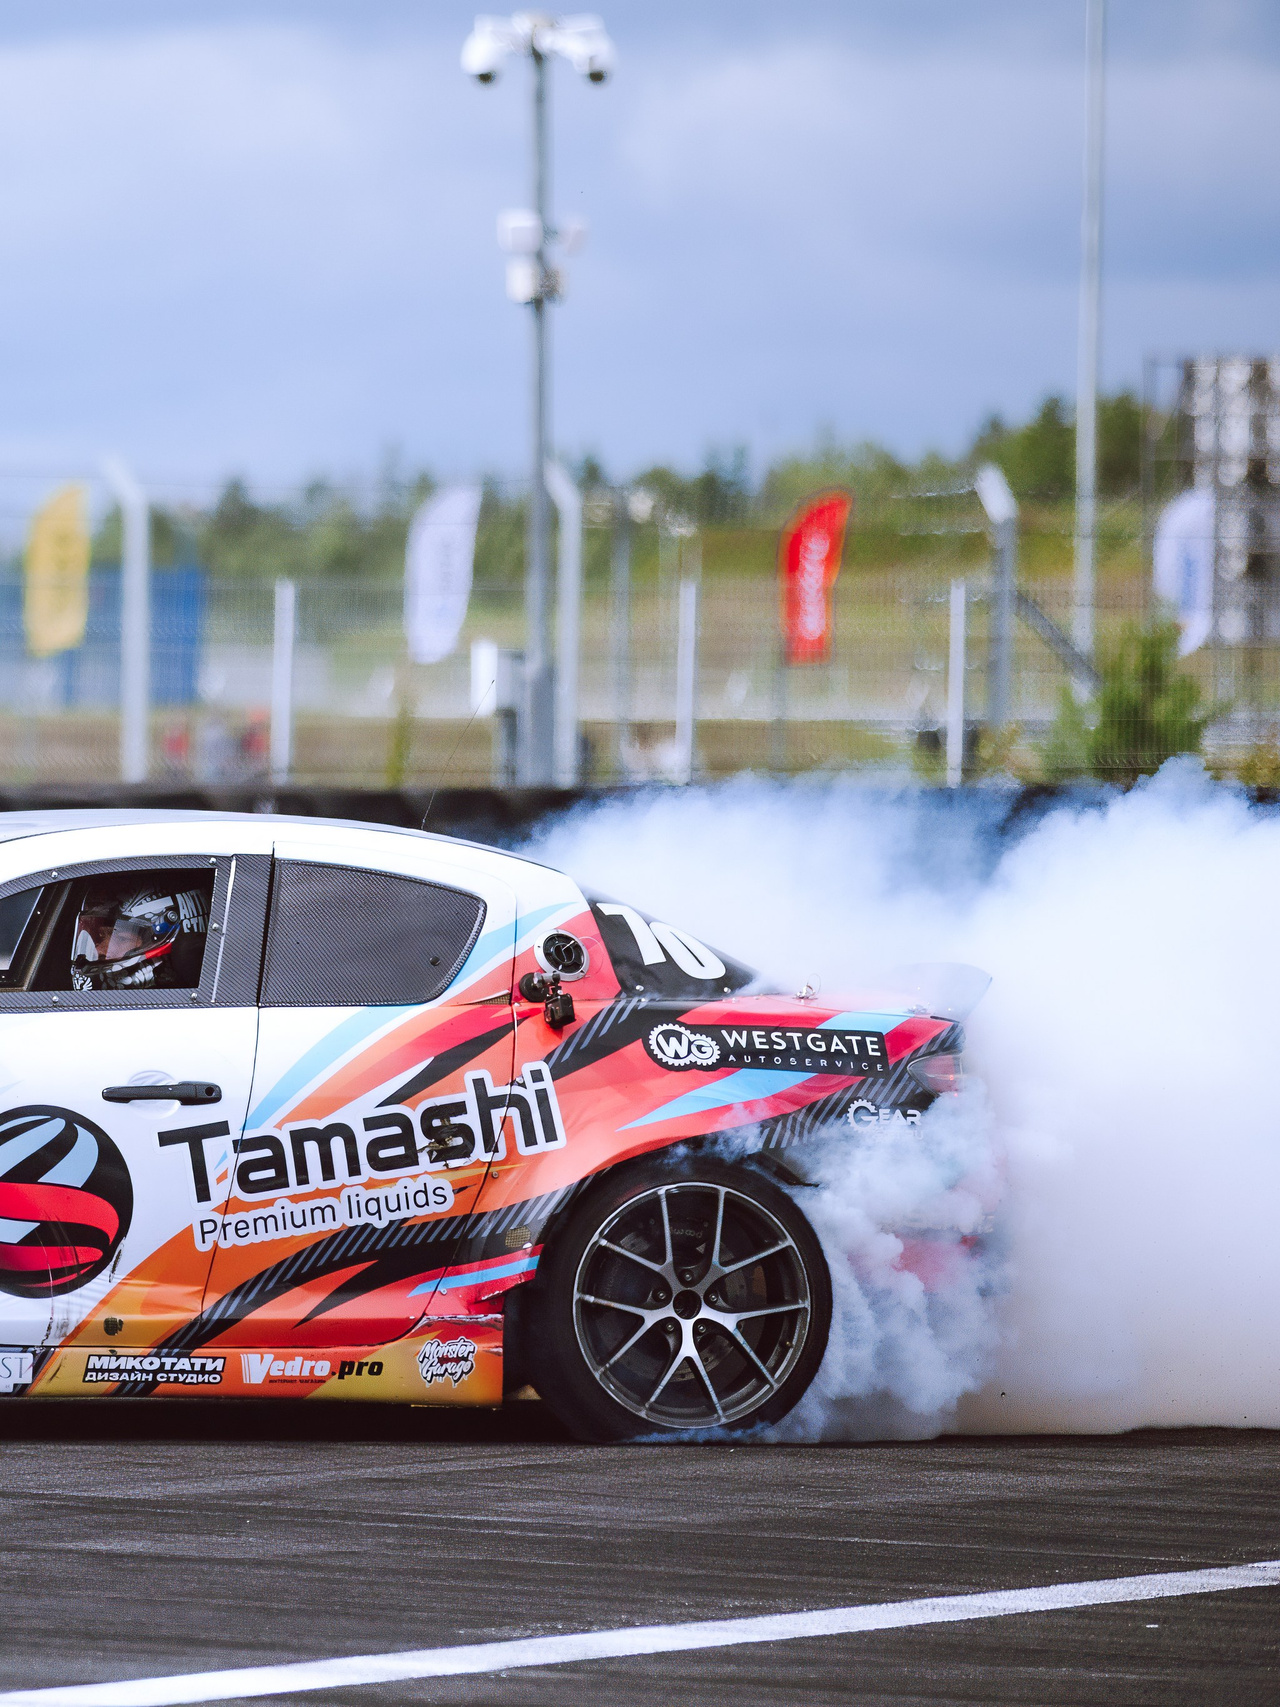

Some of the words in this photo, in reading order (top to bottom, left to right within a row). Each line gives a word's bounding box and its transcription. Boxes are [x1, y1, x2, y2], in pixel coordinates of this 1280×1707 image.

[596, 902, 726, 980] 70
[720, 1029, 881, 1057] WESTGATE
[728, 1054, 884, 1072] AUTOSERVICE
[847, 1098, 922, 1133] GEAR
[157, 1068, 560, 1204] Tamashi
[199, 1205, 337, 1245] Premium
[346, 1182, 448, 1227] liquids
[87, 1356, 225, 1372] МИКОТАТИ
[418, 1338, 476, 1363] Monster
[84, 1370, 154, 1382] ДИЗАЙН
[156, 1372, 222, 1384] СТУДИО
[239, 1353, 384, 1384] Vedro.pro
[421, 1360, 475, 1384] Garage
